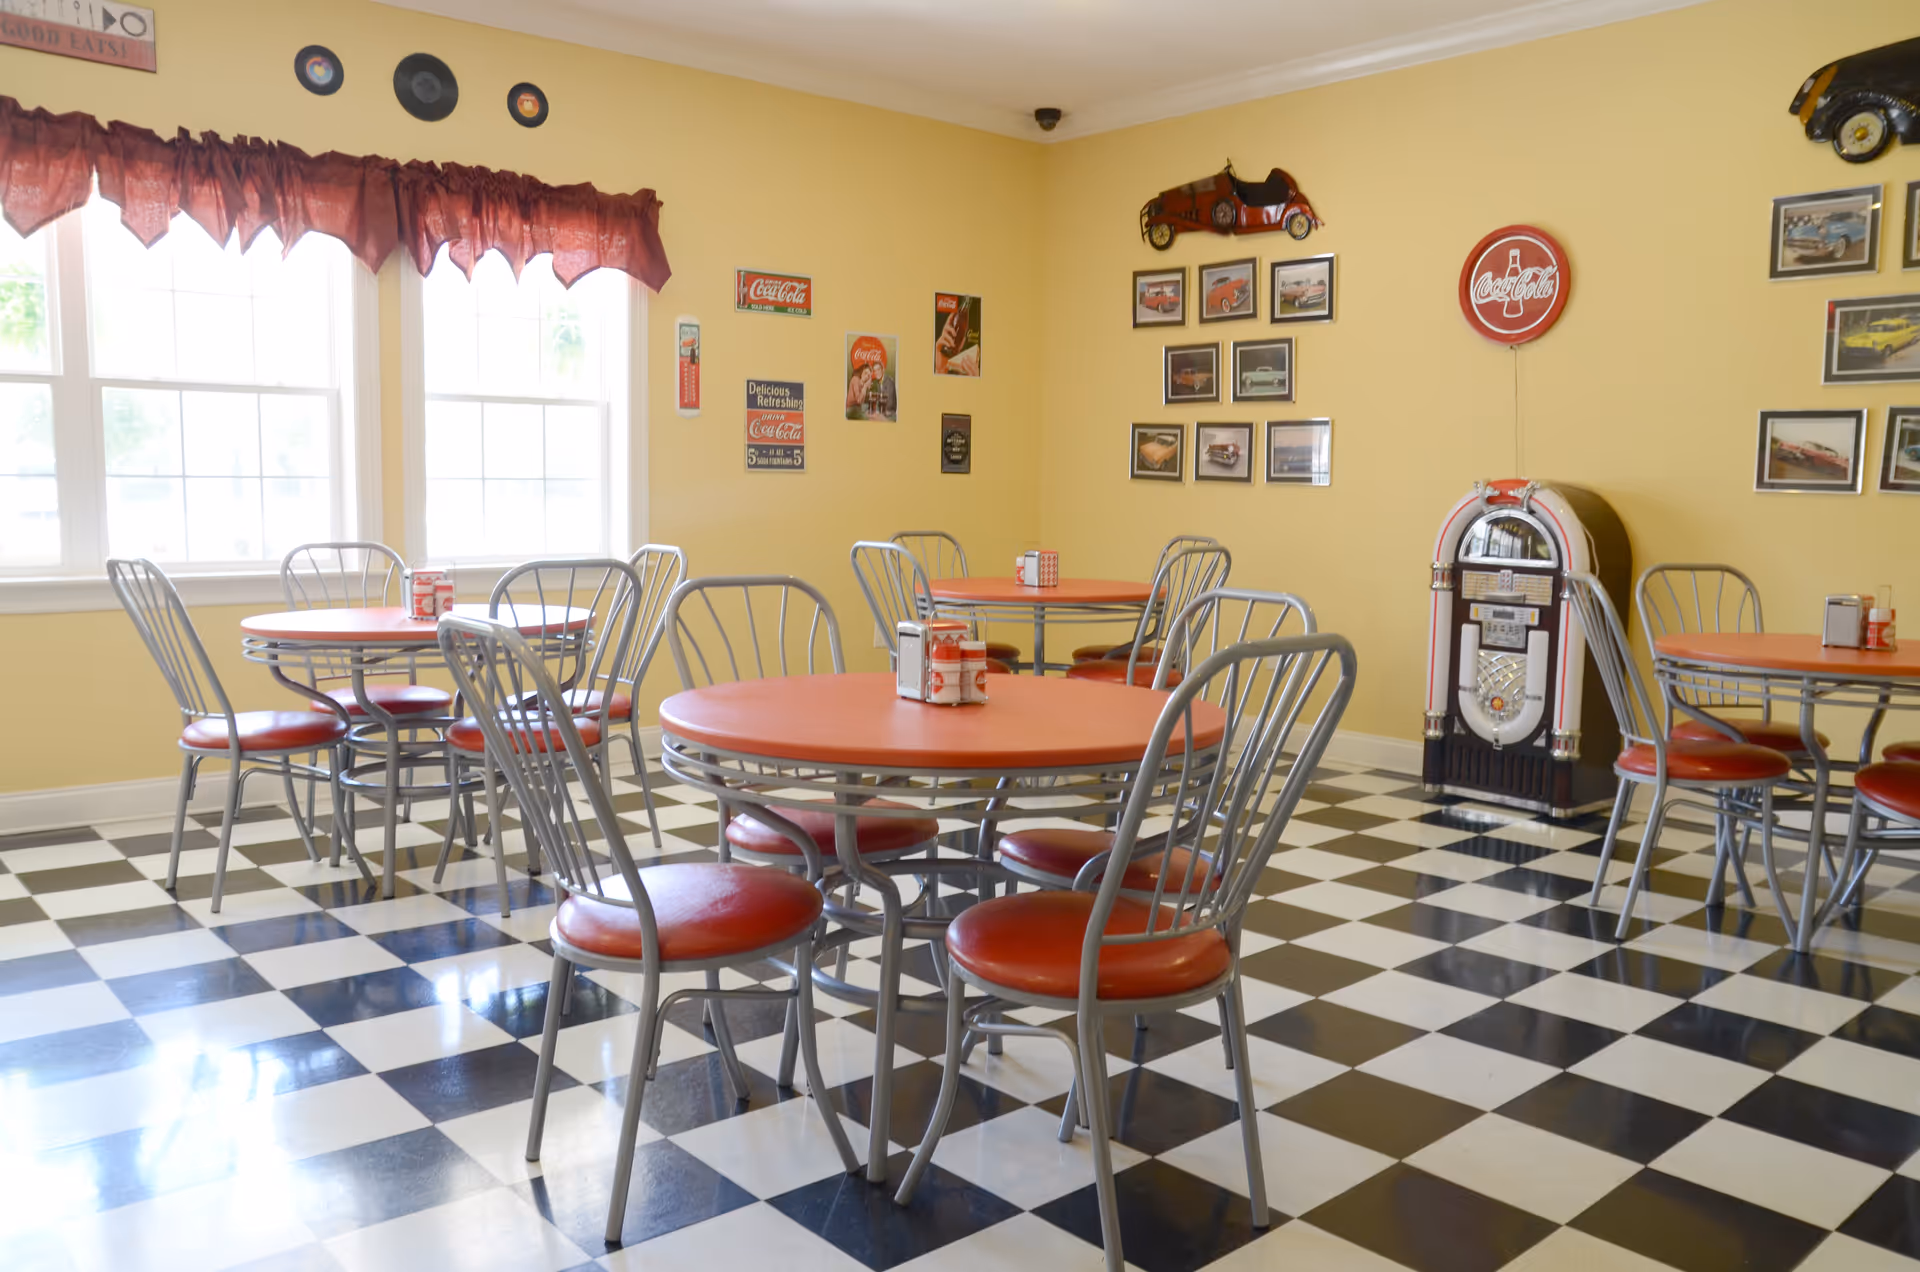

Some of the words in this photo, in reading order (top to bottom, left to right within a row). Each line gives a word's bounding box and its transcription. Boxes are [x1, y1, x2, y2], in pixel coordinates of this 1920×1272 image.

[1, 18, 60, 45] GOOD
[749, 382, 790, 396] Delicious
[757, 396, 804, 410] Refreshing
